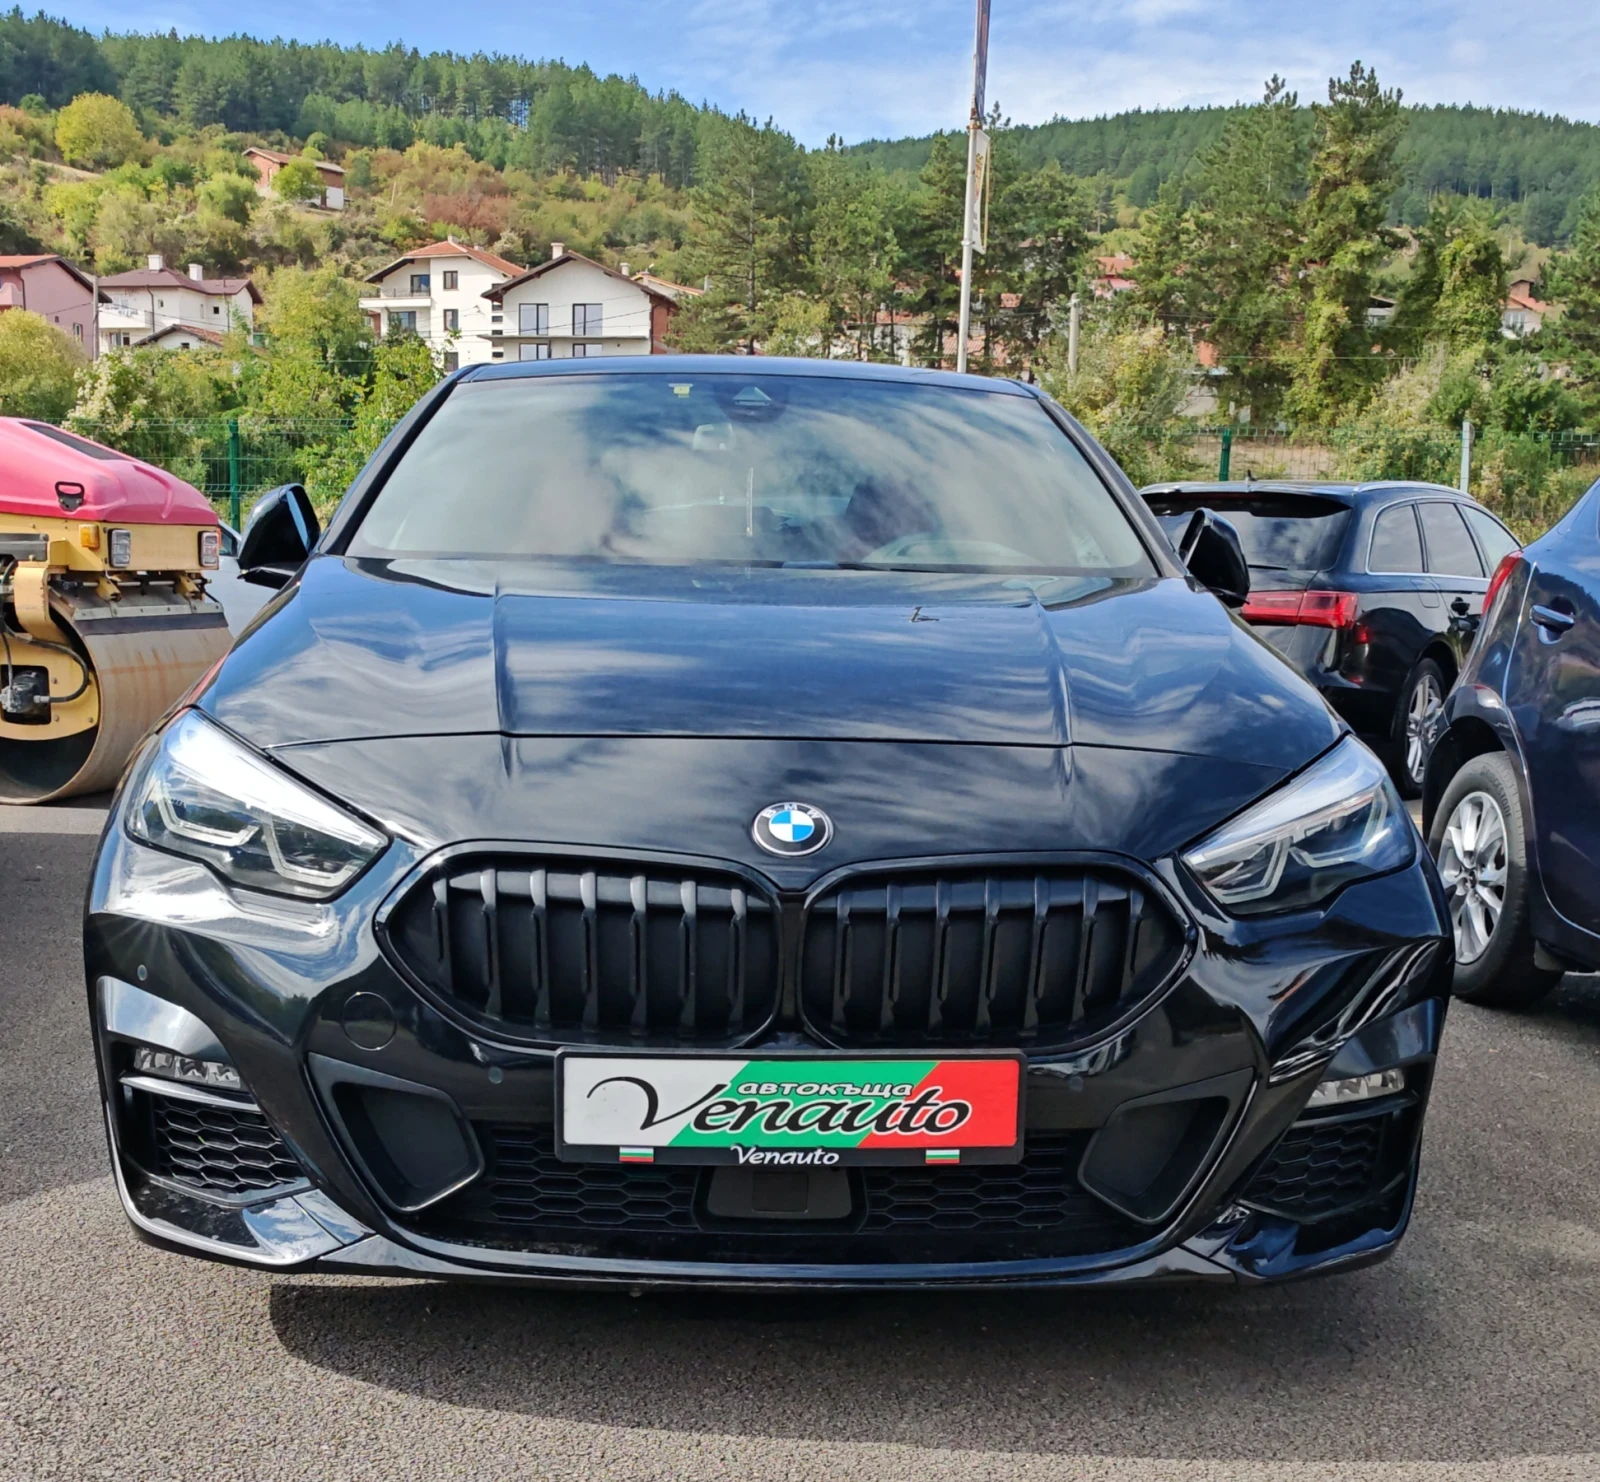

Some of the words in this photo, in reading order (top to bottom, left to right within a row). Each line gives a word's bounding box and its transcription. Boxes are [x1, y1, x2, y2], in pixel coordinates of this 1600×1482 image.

[761, 803, 821, 819] BMW
[736, 1081, 913, 1097] автокъща
[586, 1075, 971, 1133] Venauto
[730, 1144, 840, 1165] Venauto
